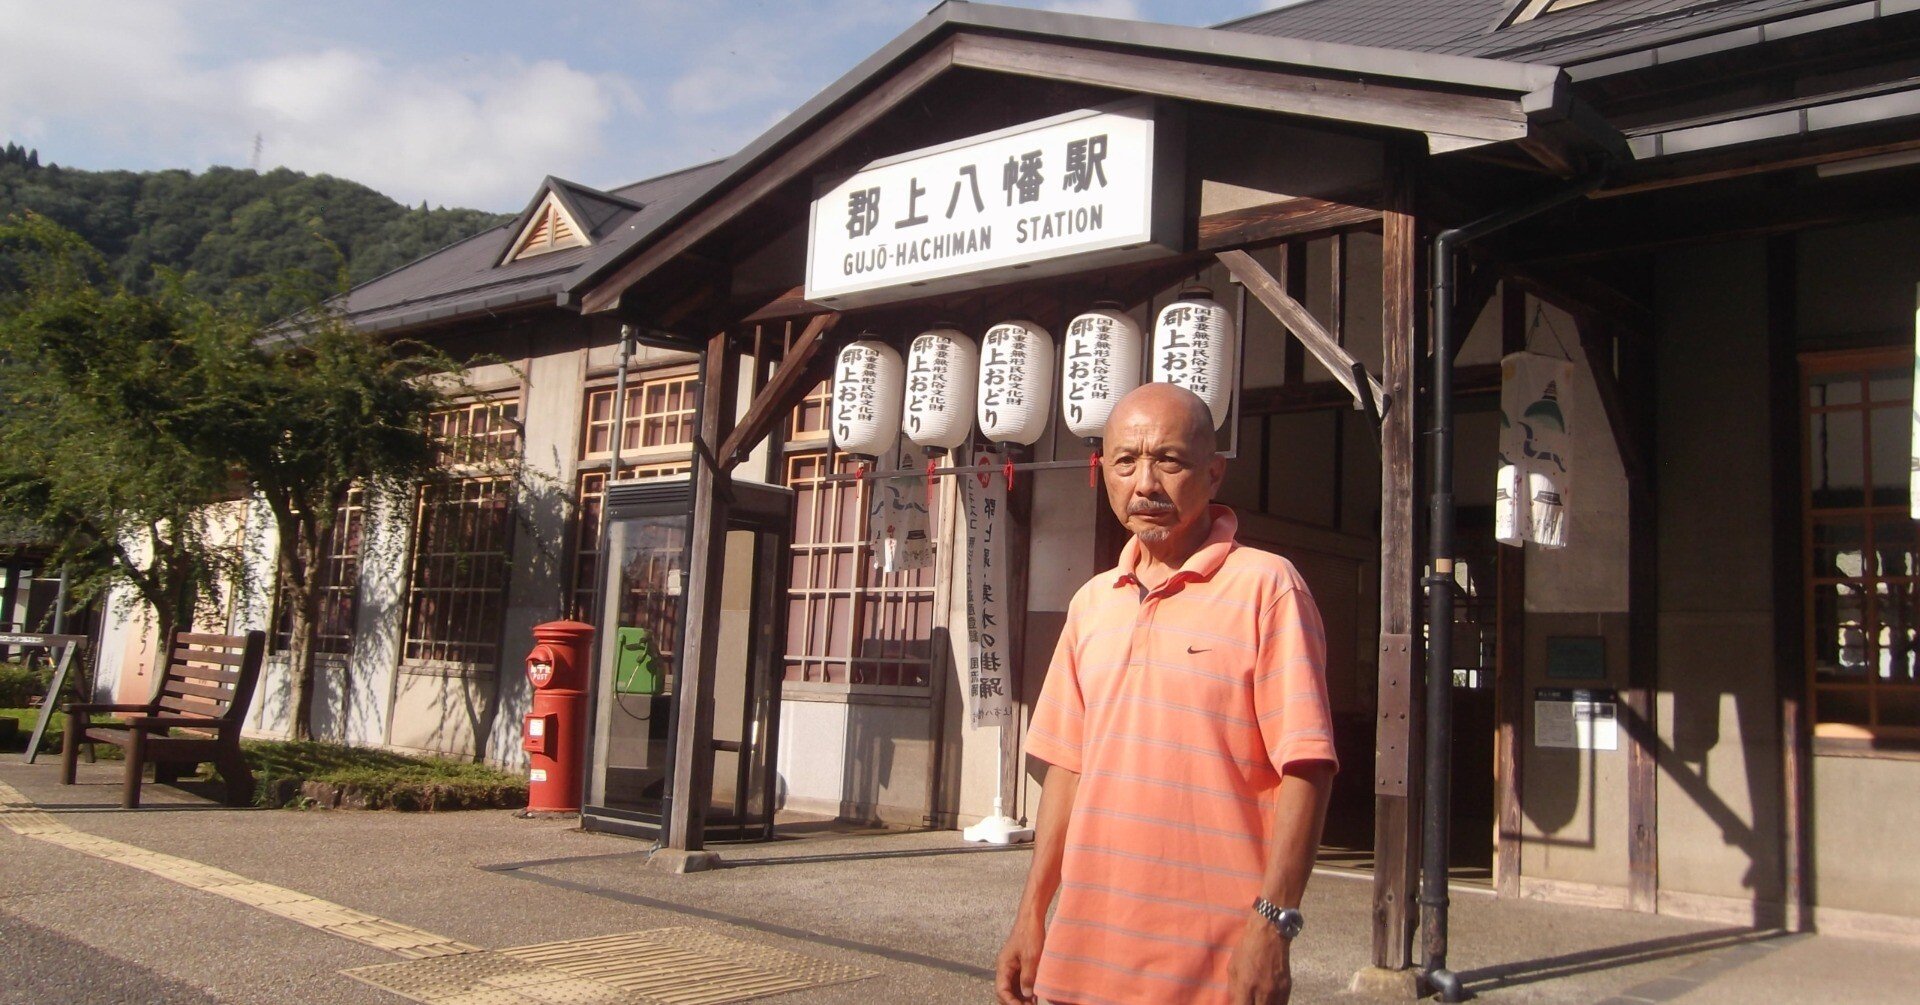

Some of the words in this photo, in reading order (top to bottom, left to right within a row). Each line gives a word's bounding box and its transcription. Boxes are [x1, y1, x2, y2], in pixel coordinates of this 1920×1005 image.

[845, 133, 1108, 240] 郡上八幡駅
[1016, 203, 1104, 244] STATION
[857, 348, 880, 422] 国重要無形民俗文化財
[909, 335, 935, 434] 郡上おどり
[929, 335, 952, 412] 国重要無形民俗文化財
[983, 327, 1011, 429] 郡上おどり
[1006, 327, 1029, 406] 国重要無形民俗文化財
[1068, 317, 1095, 424] 郡上おどり
[1091, 317, 1114, 400] 国重要無形民俗文化財
[1189, 307, 1212, 393] 国重要無形民俗文化財
[838, 347, 863, 442] 郡上おどり
